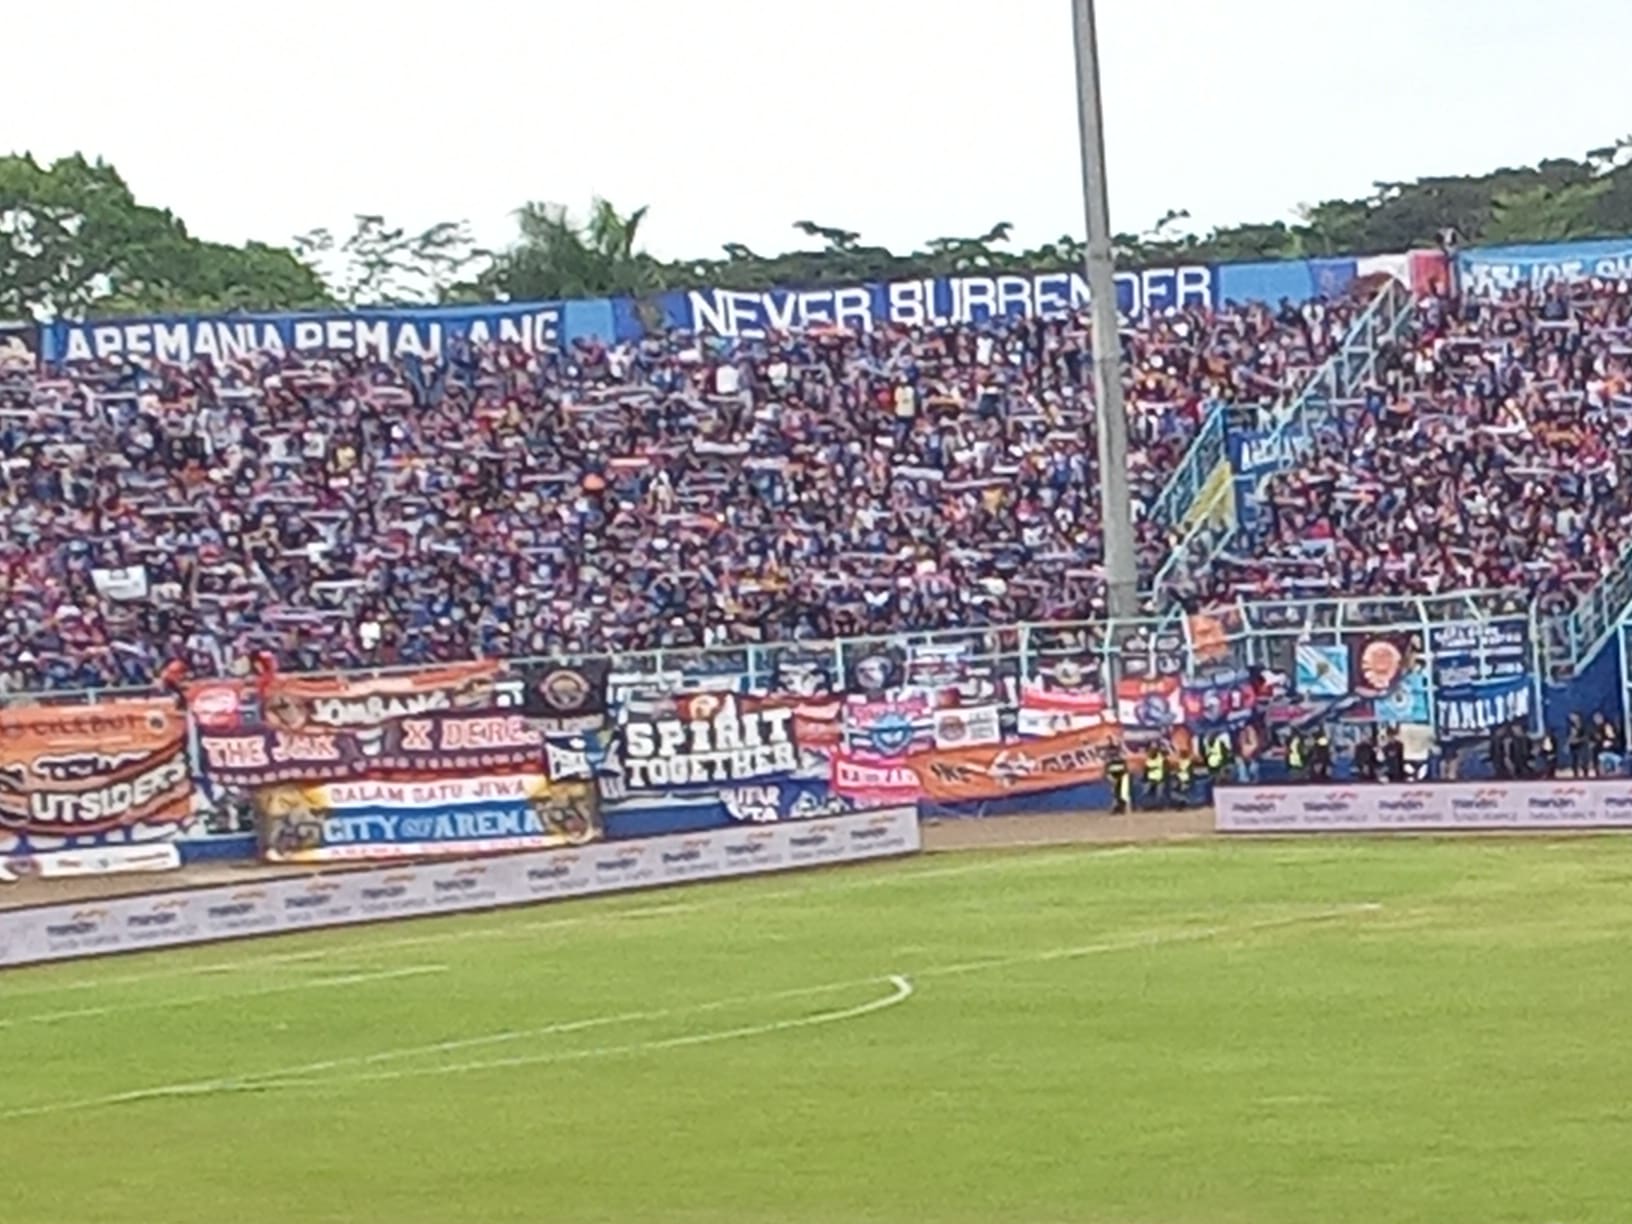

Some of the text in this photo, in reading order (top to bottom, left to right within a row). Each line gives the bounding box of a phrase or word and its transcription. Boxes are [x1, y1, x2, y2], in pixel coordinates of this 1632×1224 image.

[688, 287, 875, 338] NEVER
[202, 735, 269, 768] THE
[401, 719, 433, 751] X
[626, 706, 793, 757] SPIRIT
[623, 742, 798, 788] TOGETHER
[322, 814, 399, 843] CITY
